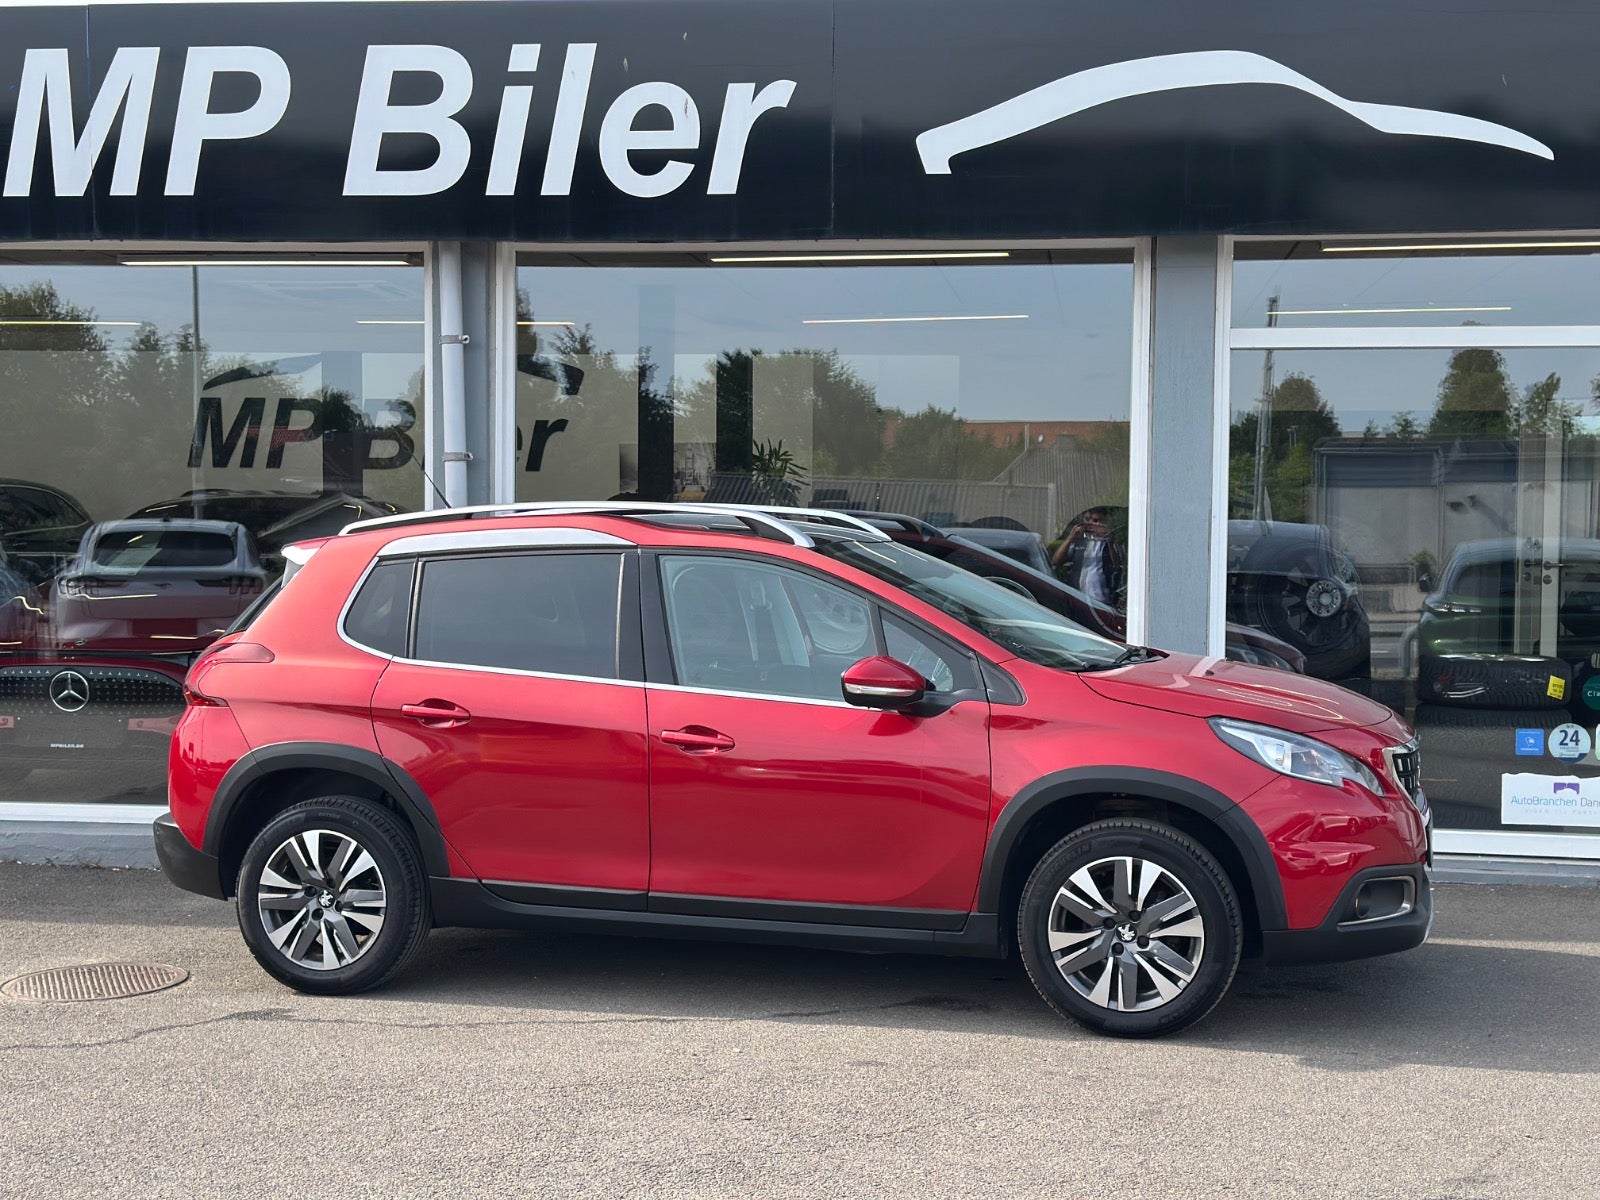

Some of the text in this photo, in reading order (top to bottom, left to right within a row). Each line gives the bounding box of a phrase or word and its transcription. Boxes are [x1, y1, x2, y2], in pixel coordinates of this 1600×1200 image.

[2, 42, 797, 198] MP Biler
[187, 396, 324, 470] MP
[1559, 729, 1581, 746] 24
[1510, 795, 1600, 807] AutoBranchen Dan
